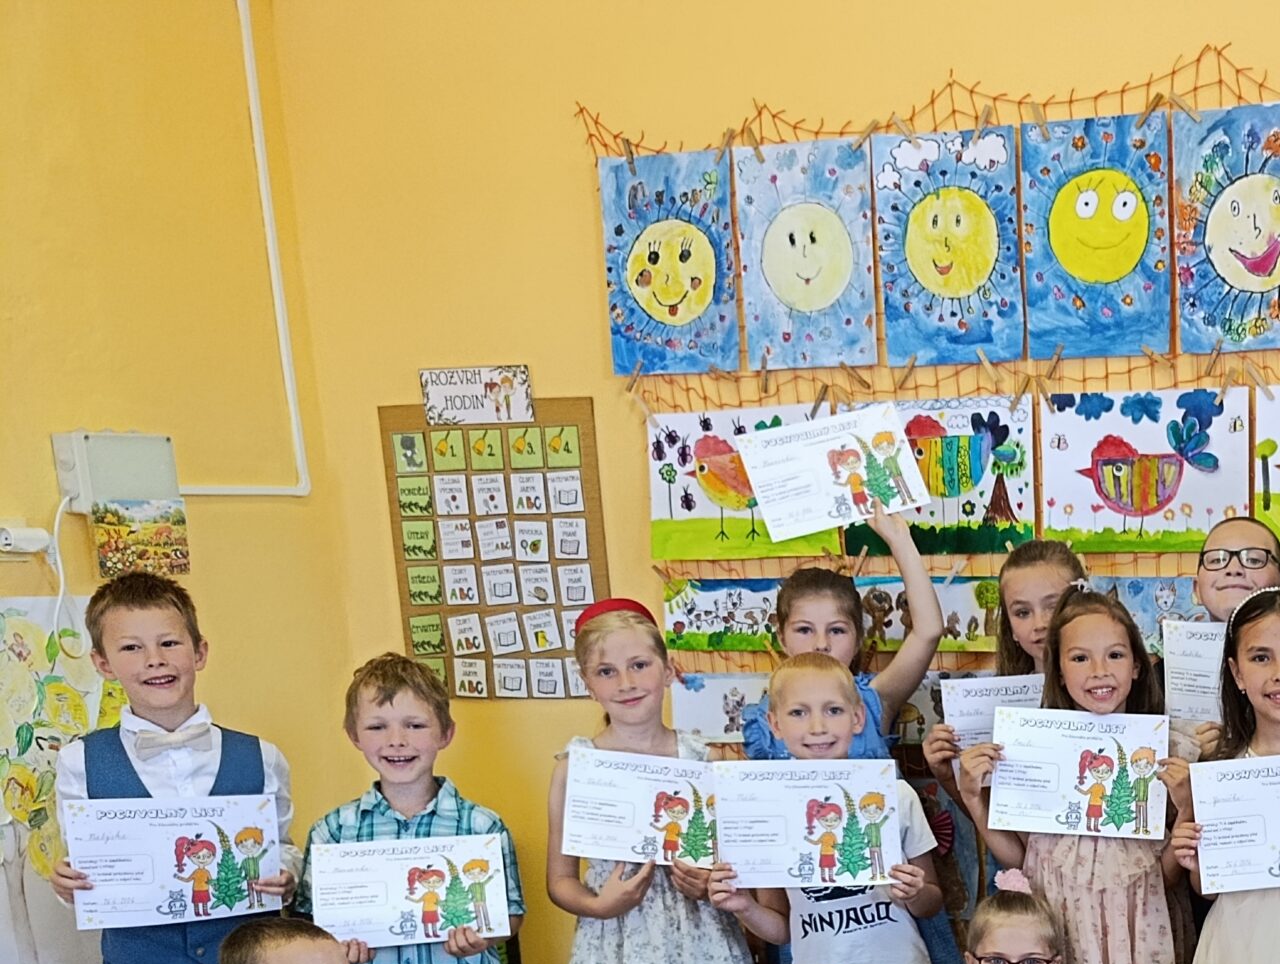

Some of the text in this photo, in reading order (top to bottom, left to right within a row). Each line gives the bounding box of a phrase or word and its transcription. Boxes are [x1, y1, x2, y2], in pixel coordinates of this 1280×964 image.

[429, 369, 482, 386] ROZVRH
[445, 394, 485, 410] HODIN
[517, 496, 542, 508] ABC
[455, 523, 470, 531] ABC
[495, 541, 511, 550] ABC
[450, 587, 474, 600] ABC
[1186, 631, 1226, 641] POCHV
[457, 636, 480, 651] ABC
[459, 680, 483, 694] ABC
[963, 685, 1029, 698] POCHVALNÝ
[1019, 718, 1126, 734] POCHVALNÝ LIST
[674, 768, 702, 779] LIST
[739, 771, 851, 780] POCHVALNÝ LIST
[96, 807, 224, 820] POCHVALNÝ LIST
[800, 901, 899, 940] NINJAGO
